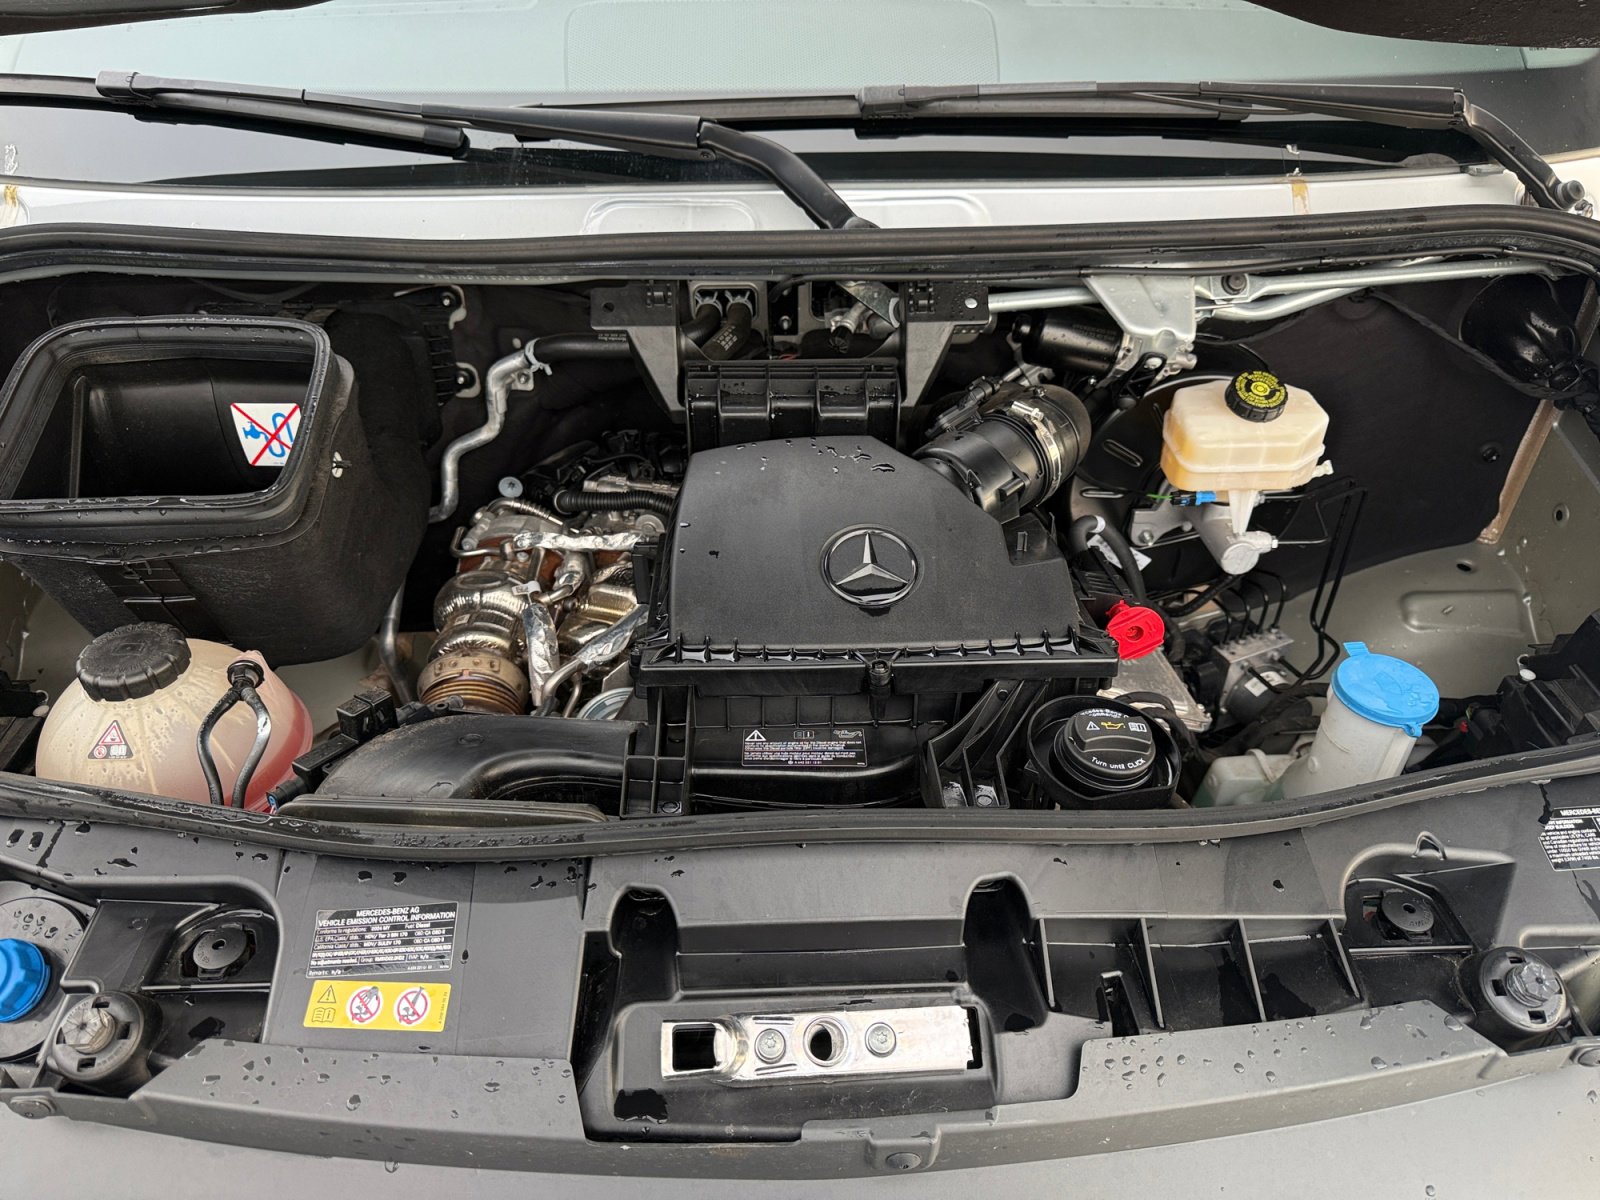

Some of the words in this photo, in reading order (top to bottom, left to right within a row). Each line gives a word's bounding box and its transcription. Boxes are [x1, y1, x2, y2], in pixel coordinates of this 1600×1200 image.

[1091, 757, 1107, 767] Turn
[1127, 758, 1146, 768] CLICK
[356, 907, 408, 917] MERCEDES-BENZ
[346, 917, 378, 925] EMISSION
[379, 915, 410, 923] CONTROL
[411, 912, 455, 922] INFORMATION
